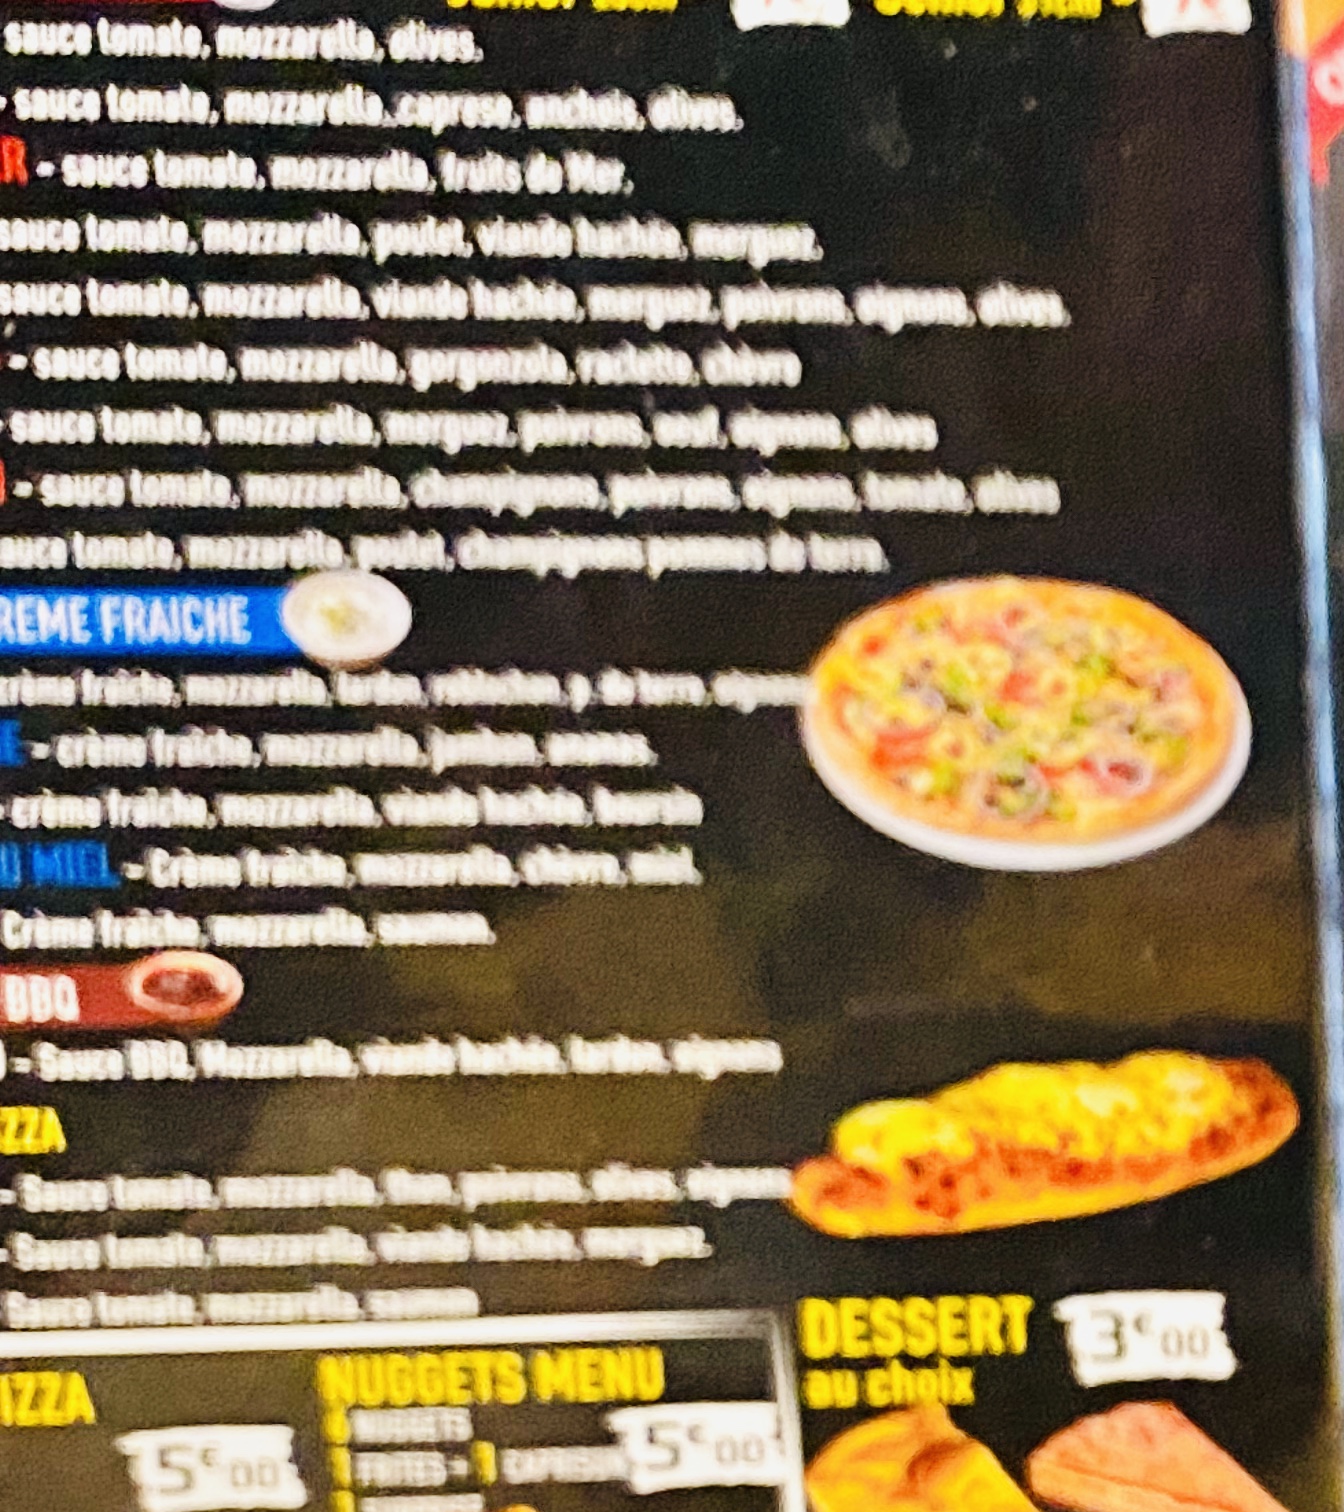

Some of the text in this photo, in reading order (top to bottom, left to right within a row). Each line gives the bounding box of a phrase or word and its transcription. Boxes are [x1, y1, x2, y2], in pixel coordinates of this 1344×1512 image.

[100, 593, 252, 645] FRAICHE
[3, 973, 80, 1024] BBQ
[802, 1294, 1035, 1360] DESSERT
[316, 1346, 666, 1407] NUGGETS MENU
[803, 1357, 976, 1409] au choix
